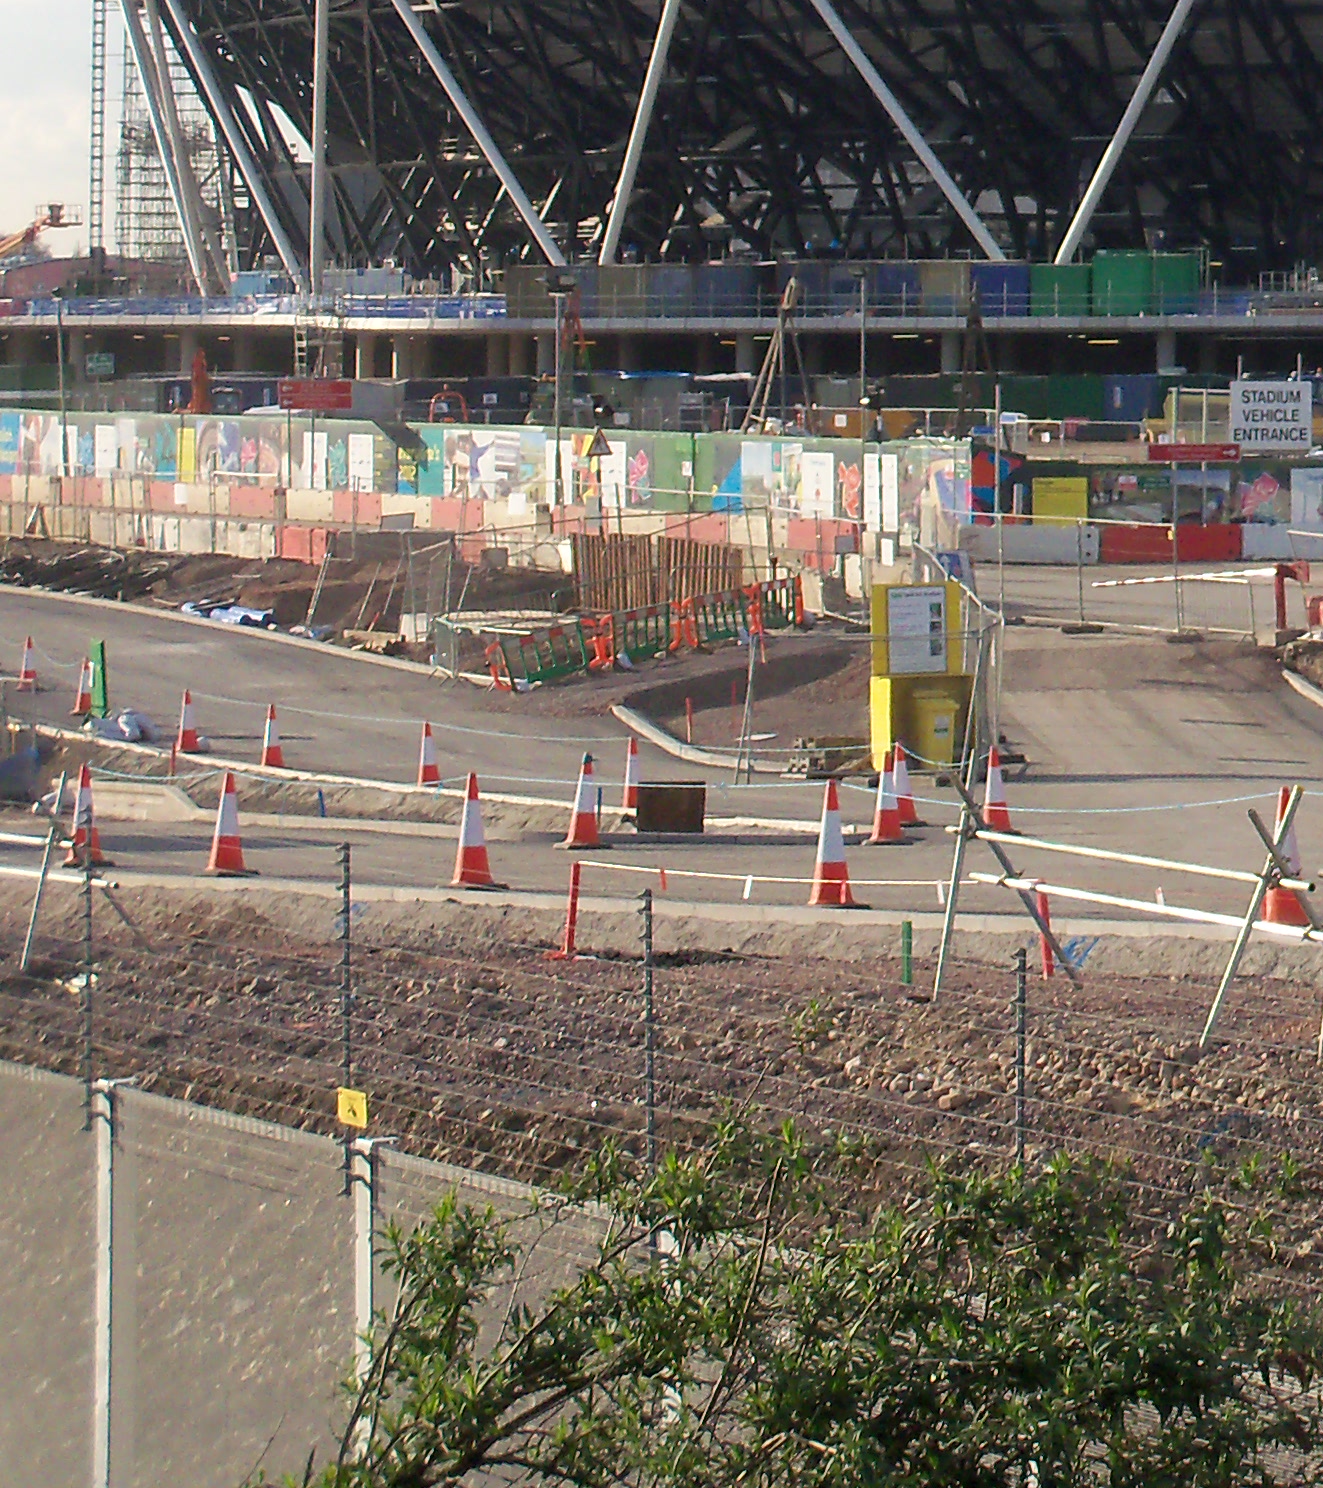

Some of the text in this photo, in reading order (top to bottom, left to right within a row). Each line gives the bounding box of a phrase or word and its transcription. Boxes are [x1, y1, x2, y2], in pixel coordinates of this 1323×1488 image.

[1242, 389, 1301, 404] STADIUM
[1242, 408, 1300, 422] VEHICLE
[1233, 427, 1308, 441] ENTRANCE
